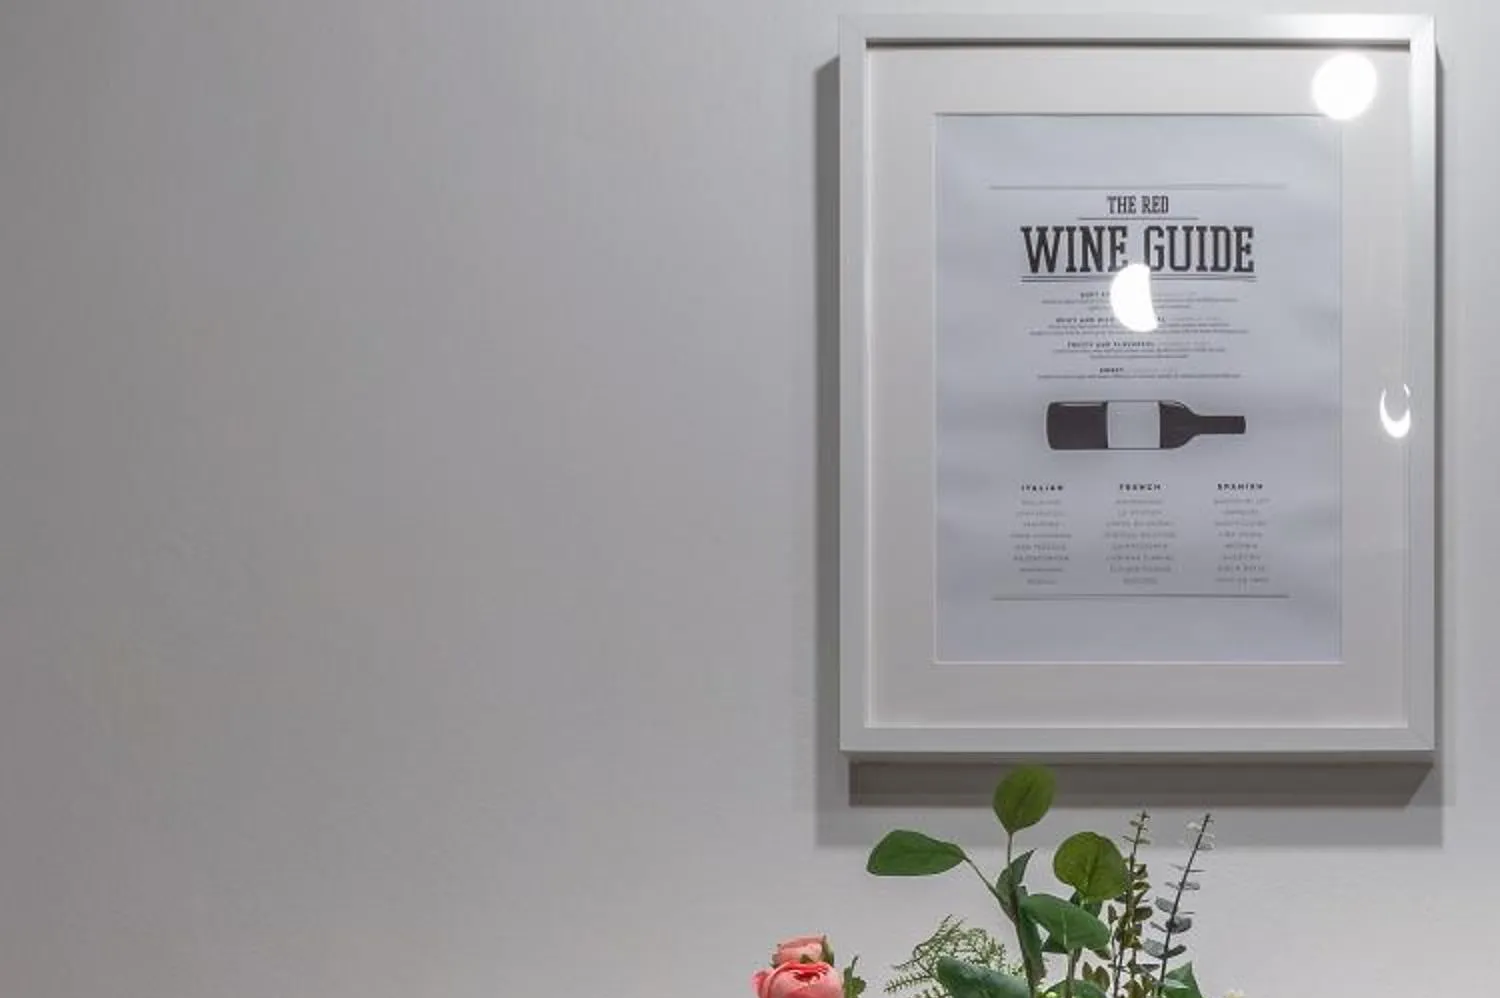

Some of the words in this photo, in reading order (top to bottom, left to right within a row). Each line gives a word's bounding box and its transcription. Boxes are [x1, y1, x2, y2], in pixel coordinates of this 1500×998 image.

[1106, 195, 1137, 214] THE
[1142, 195, 1169, 214] RED
[1020, 226, 1129, 273] WINE
[1143, 226, 1256, 273] GUIDE
